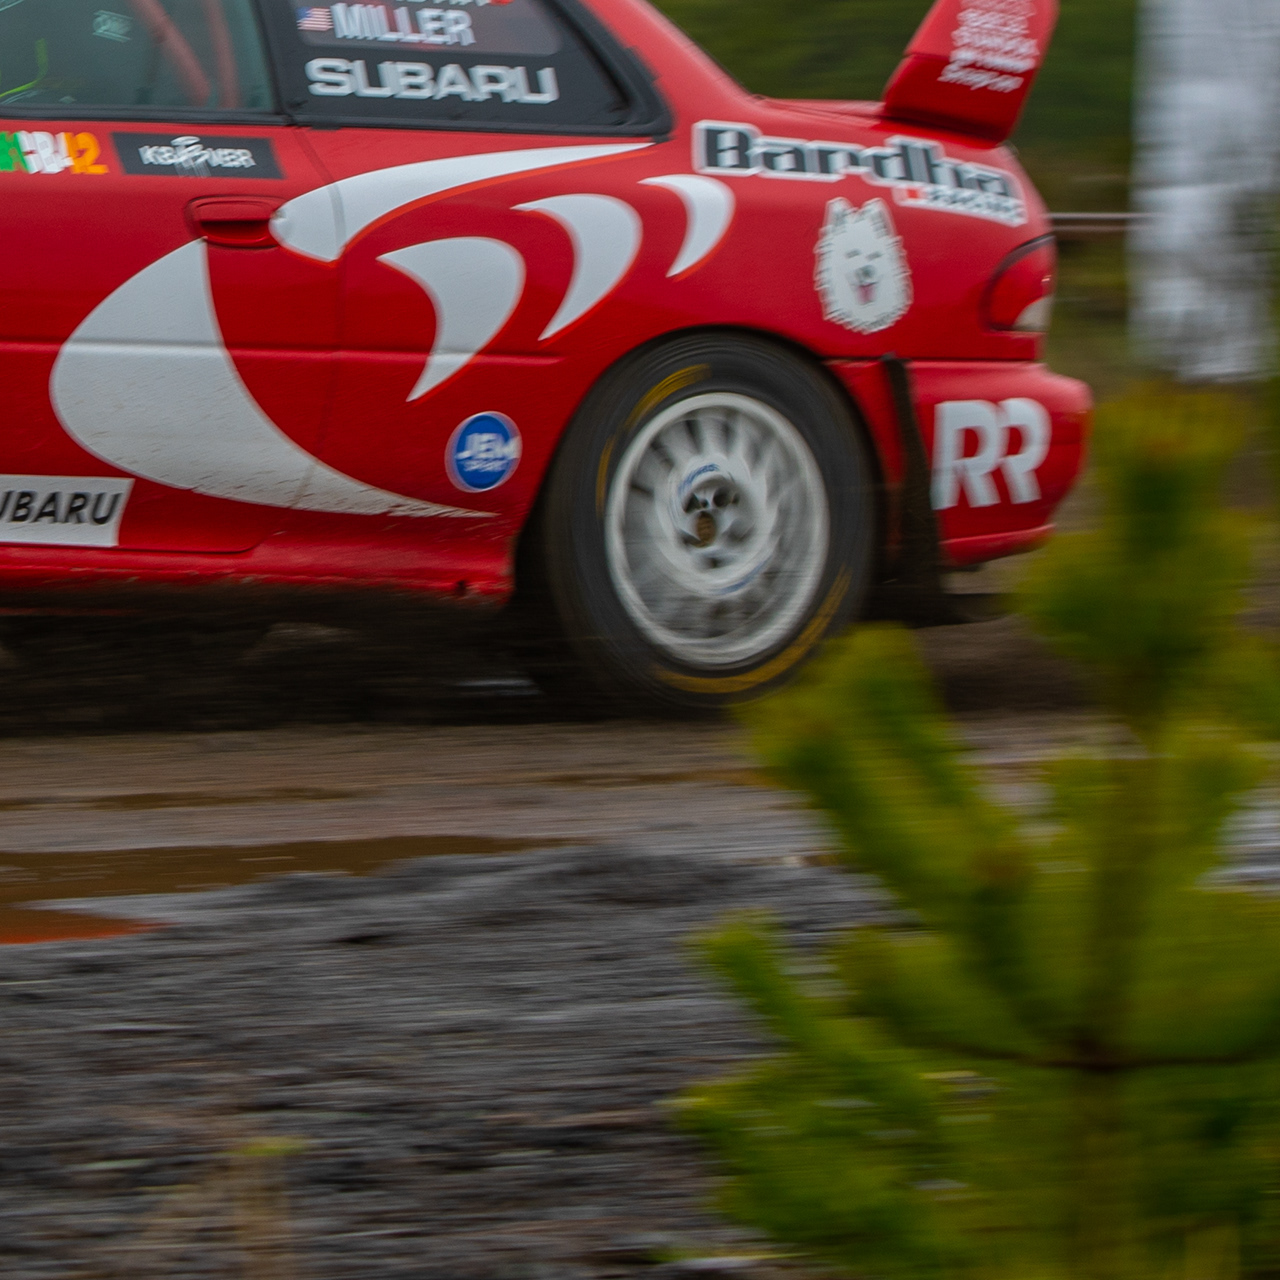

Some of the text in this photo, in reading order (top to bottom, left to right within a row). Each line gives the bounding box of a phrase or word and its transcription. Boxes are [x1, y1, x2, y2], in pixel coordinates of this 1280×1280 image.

[331, 3, 476, 46] MILLER
[305, 58, 560, 104] SUBARU
[698, 124, 1020, 198] Bardha
[929, 397, 1053, 510] RR
